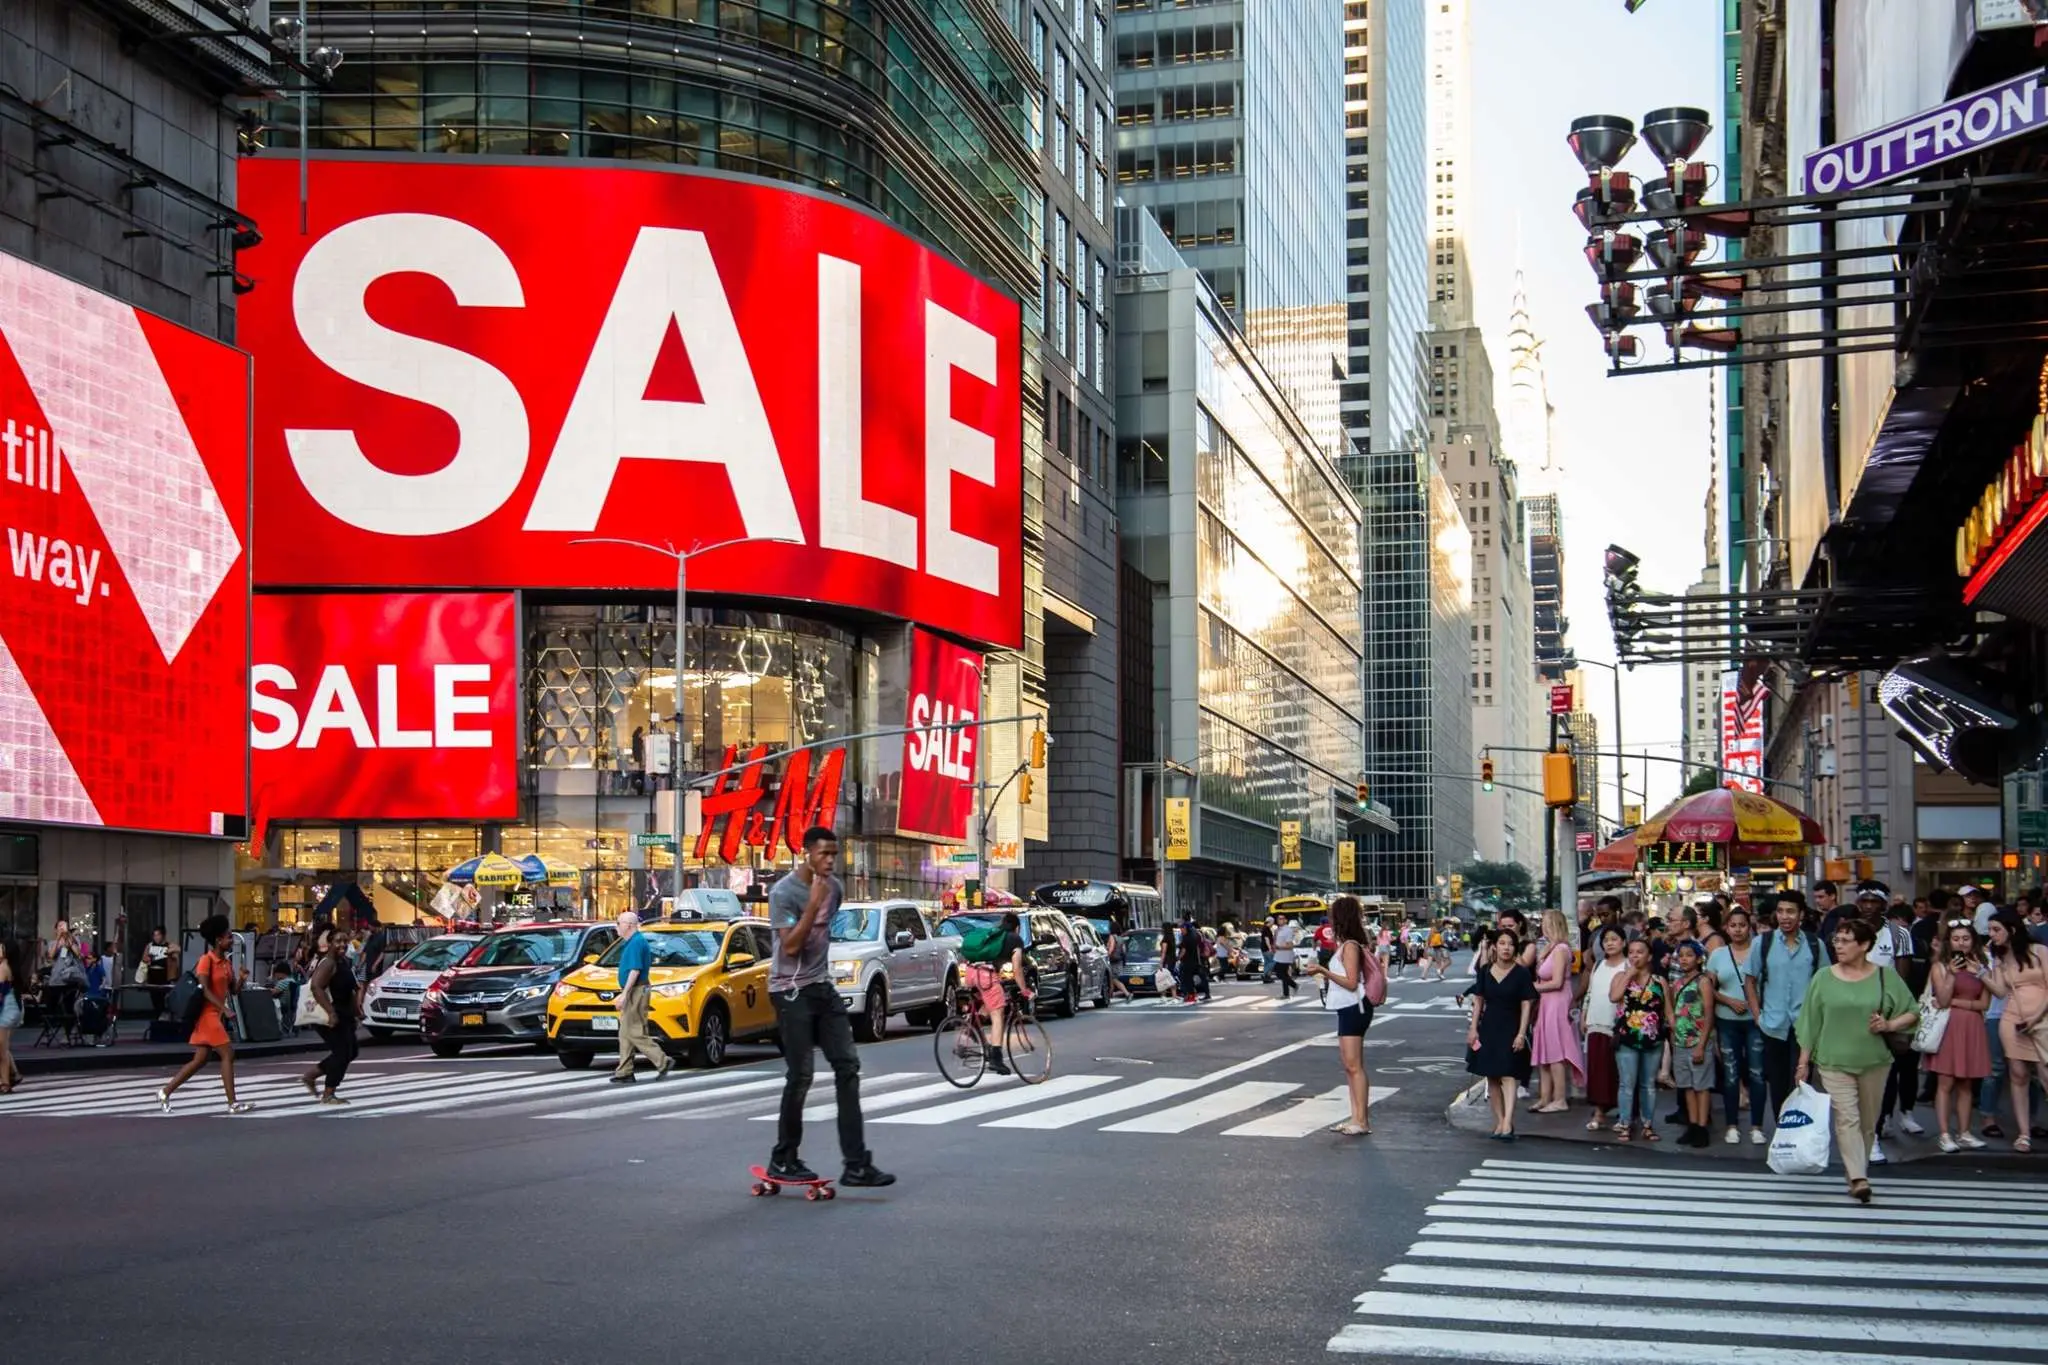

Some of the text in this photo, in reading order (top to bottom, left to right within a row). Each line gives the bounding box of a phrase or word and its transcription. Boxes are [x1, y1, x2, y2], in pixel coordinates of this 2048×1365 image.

[284, 212, 1000, 597] SALE
[0, 418, 61, 494] till
[7, 527, 110, 607] way.
[249, 663, 493, 750] SALE
[909, 692, 974, 782] SALE
[693, 743, 846, 864] H&M
